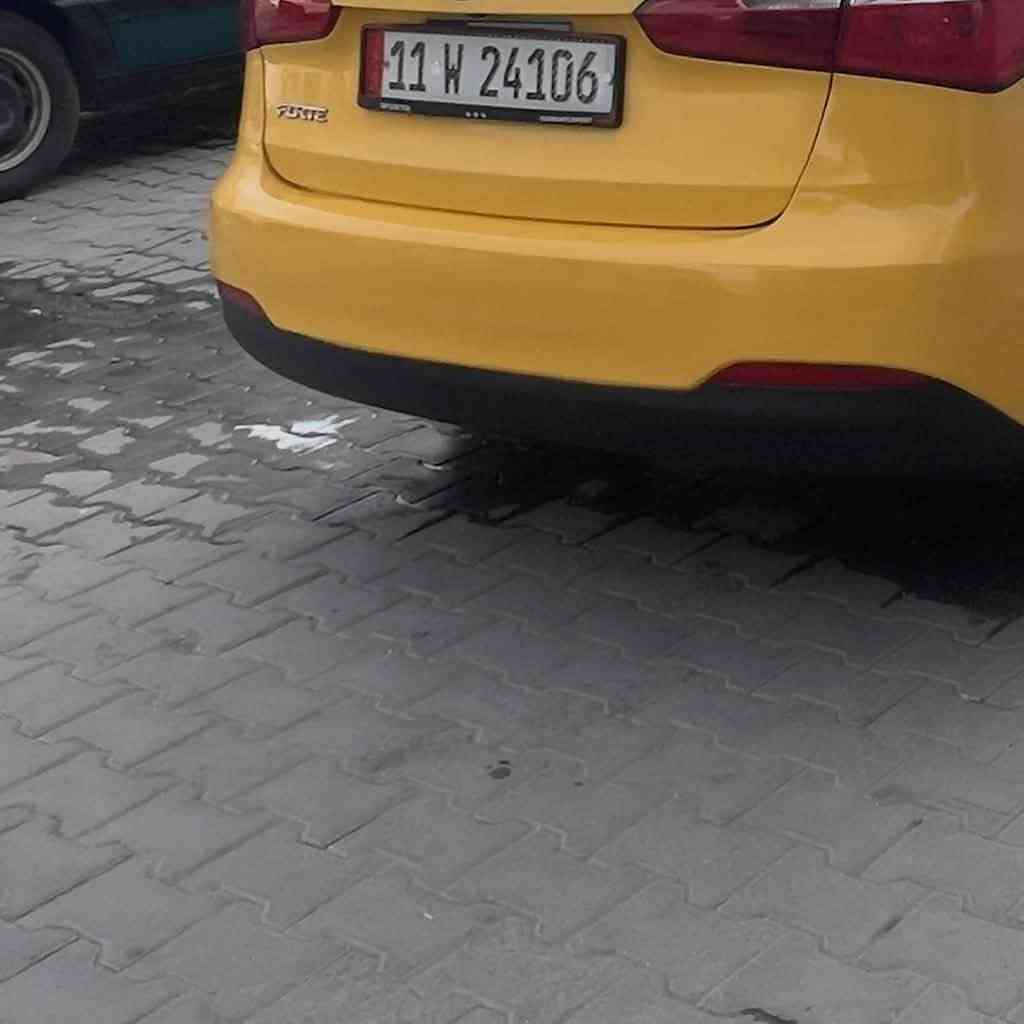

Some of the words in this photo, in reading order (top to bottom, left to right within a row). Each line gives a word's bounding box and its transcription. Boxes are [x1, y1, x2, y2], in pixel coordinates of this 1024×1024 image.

[388, 39, 426, 93] 11
[444, 42, 465, 95] W
[479, 45, 599, 104] 24106
